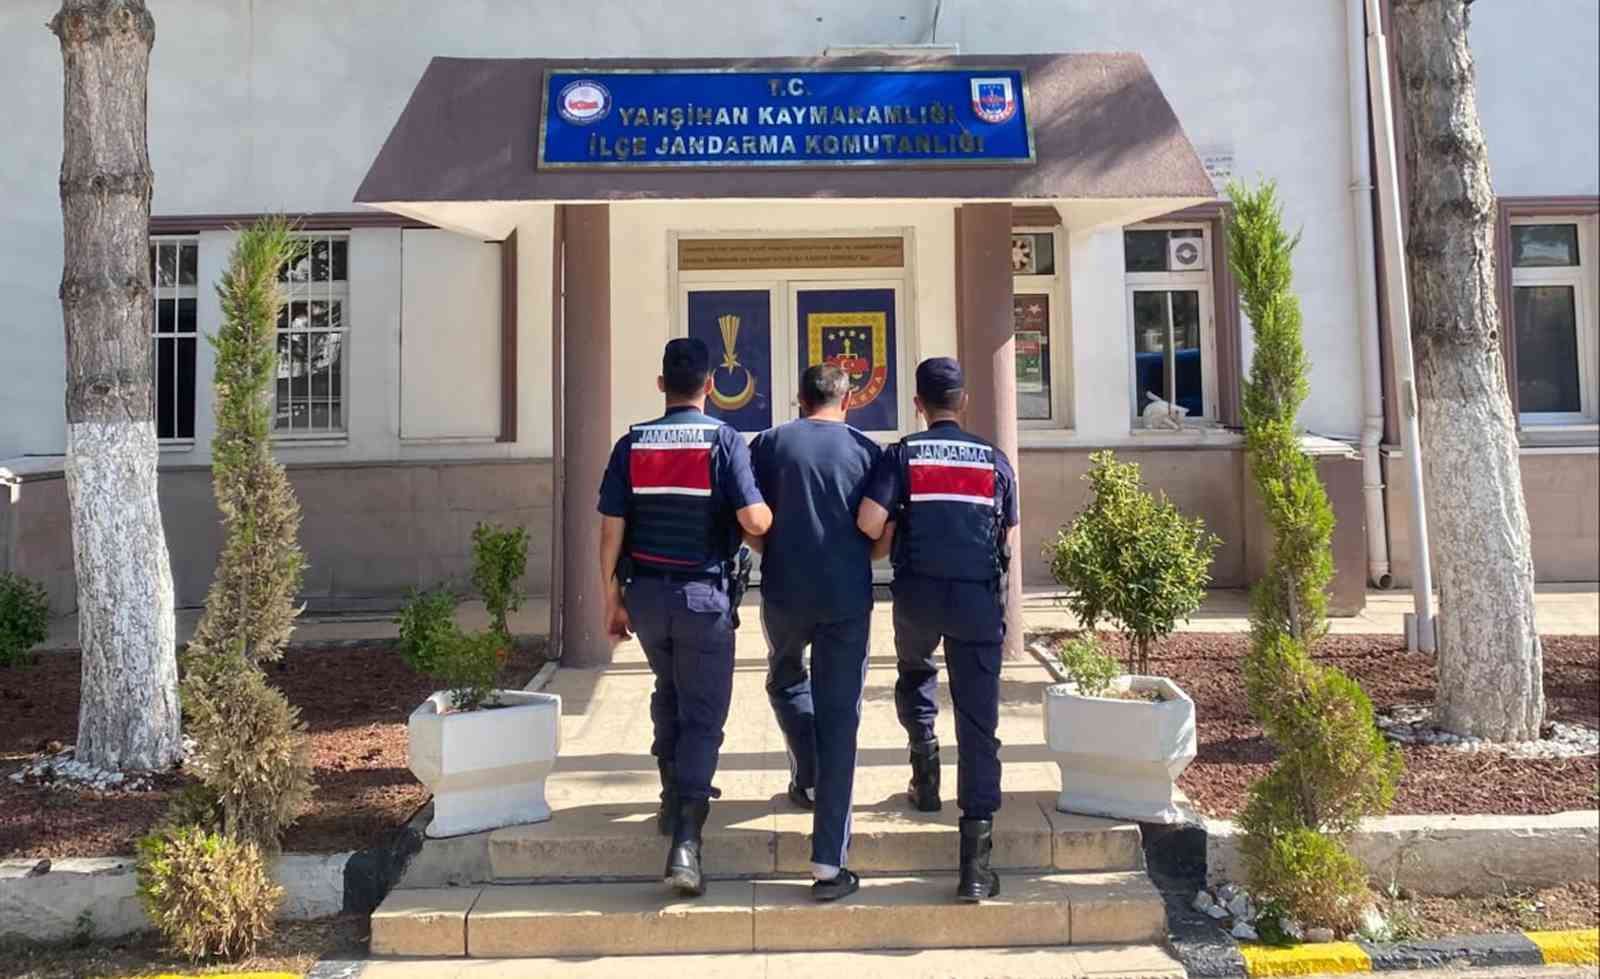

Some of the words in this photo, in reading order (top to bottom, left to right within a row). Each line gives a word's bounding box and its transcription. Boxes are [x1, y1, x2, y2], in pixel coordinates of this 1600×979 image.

[767, 78, 812, 97] T.C.
[619, 103, 749, 131] YAHŞİHAN
[758, 100, 955, 125] KAYMAKAMLIĞI
[588, 132, 647, 160] İLÇE
[655, 135, 797, 155] JANDARMA
[805, 130, 985, 154] KOMUTANLIĞI
[639, 429, 705, 443] JANDARMA
[916, 445, 988, 463] JANDARMA
